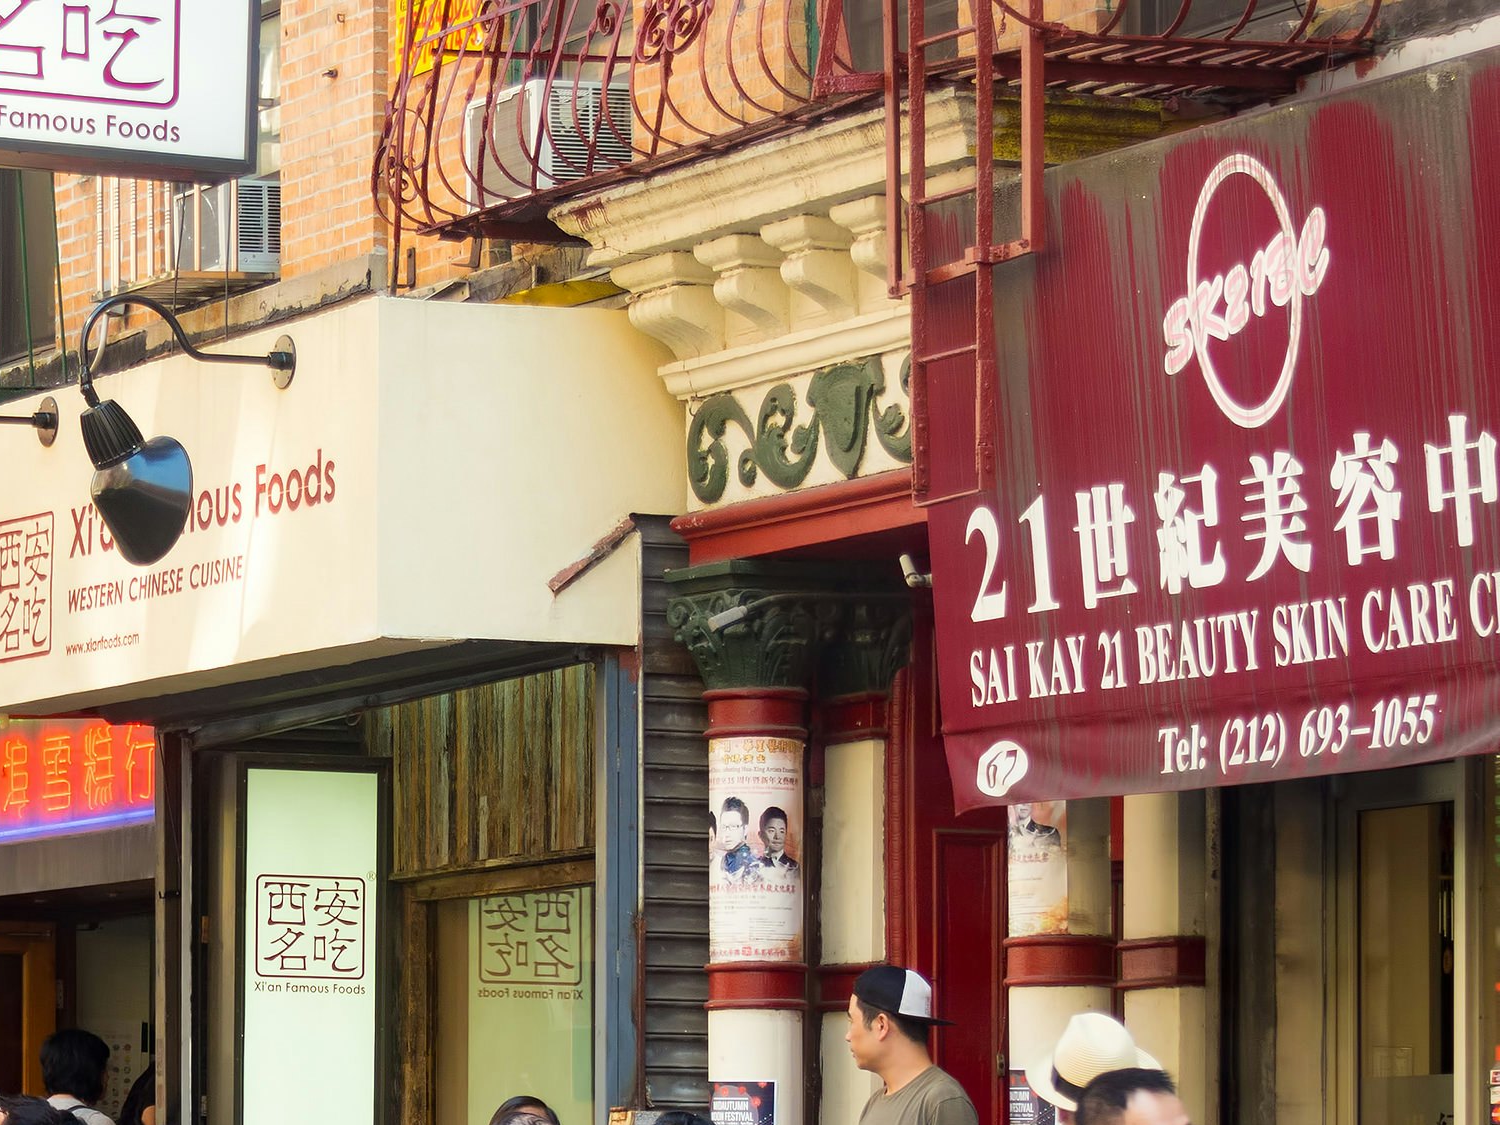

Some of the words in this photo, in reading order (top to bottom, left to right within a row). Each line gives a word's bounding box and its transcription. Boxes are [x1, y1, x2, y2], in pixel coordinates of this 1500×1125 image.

[106, 115, 181, 143] Foods
[255, 449, 336, 518] Foods
[964, 413, 1497, 623] 21世紀美容中
[68, 578, 123, 615] WESTERN
[129, 568, 183, 602] CHINESE
[189, 555, 243, 591] CUISINE
[65, 632, 140, 656] www.xianfoods.com
[970, 646, 1018, 708] SAI
[1026, 635, 1086, 699] KAY
[1097, 630, 1127, 690] 21
[1135, 609, 1260, 685] BEAUTY
[1272, 597, 1350, 668] SKIN
[1361, 579, 1458, 655] CARE
[1158, 724, 1207, 775] Tel:
[1219, 712, 1287, 776] (212)
[984, 748, 1019, 790] 67
[264, 881, 360, 926] 西安
[263, 927, 359, 973] 名吃
[254, 981, 282, 992] Xi'an
[285, 982, 329, 994] Famous
[333, 984, 366, 995] Foods
[725, 1111, 754, 1121] FESTIVAL
